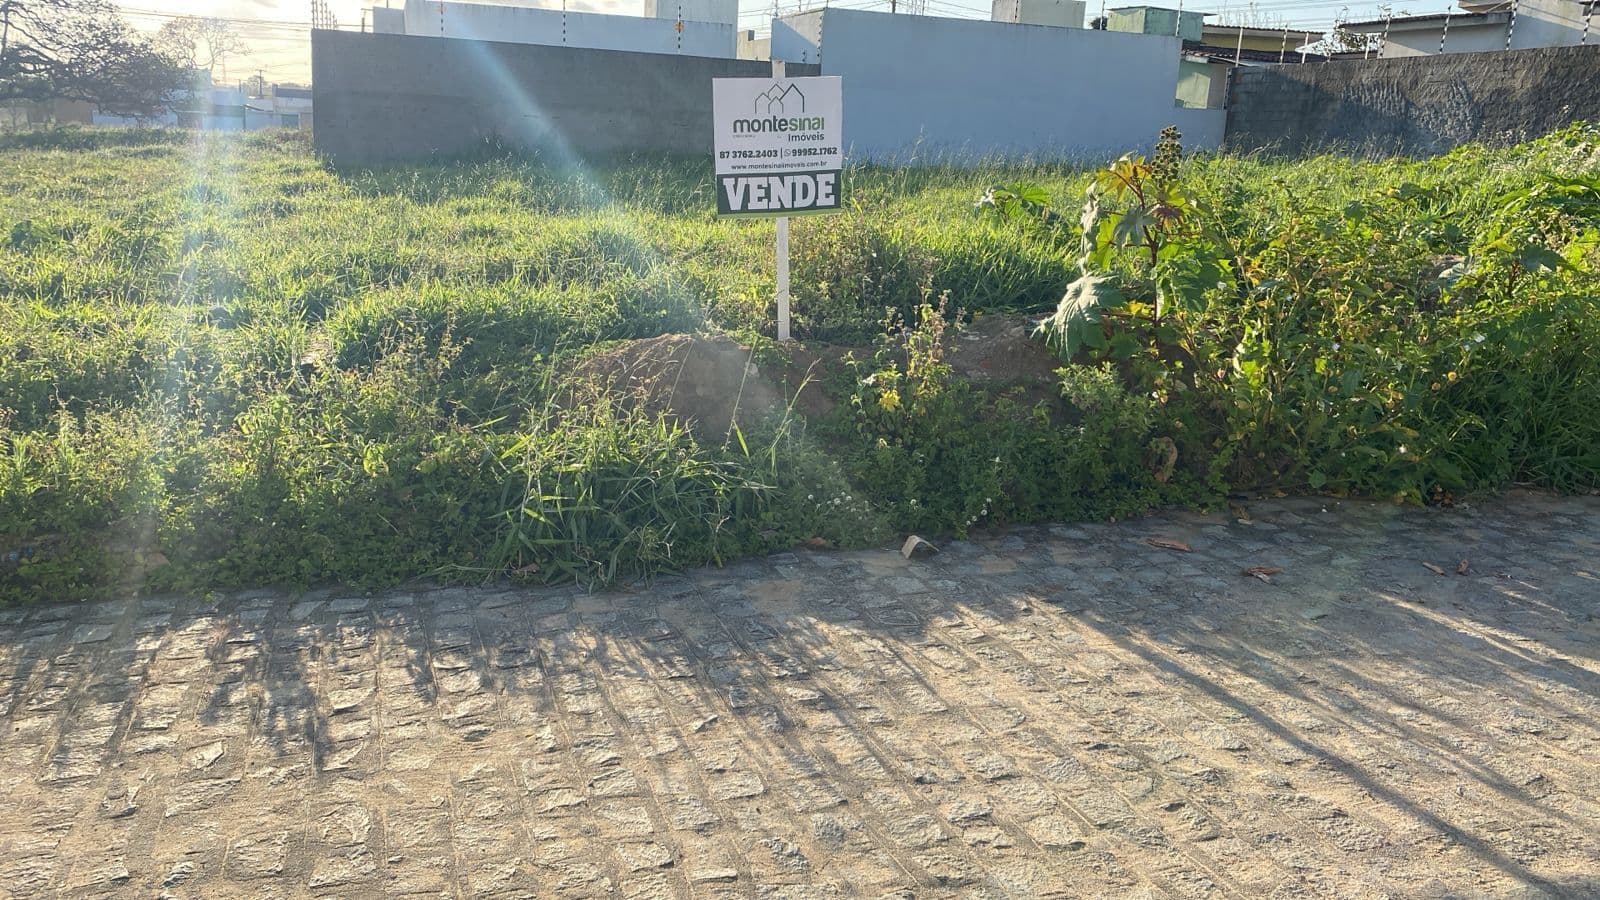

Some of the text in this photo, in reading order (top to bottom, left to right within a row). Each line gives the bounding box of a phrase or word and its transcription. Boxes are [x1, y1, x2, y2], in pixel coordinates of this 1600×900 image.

[733, 115, 825, 133] montesinai
[788, 132, 825, 142] Imóveis
[719, 147, 838, 159] 87 3762.2403 99952.1762
[723, 173, 835, 211] VENDE
